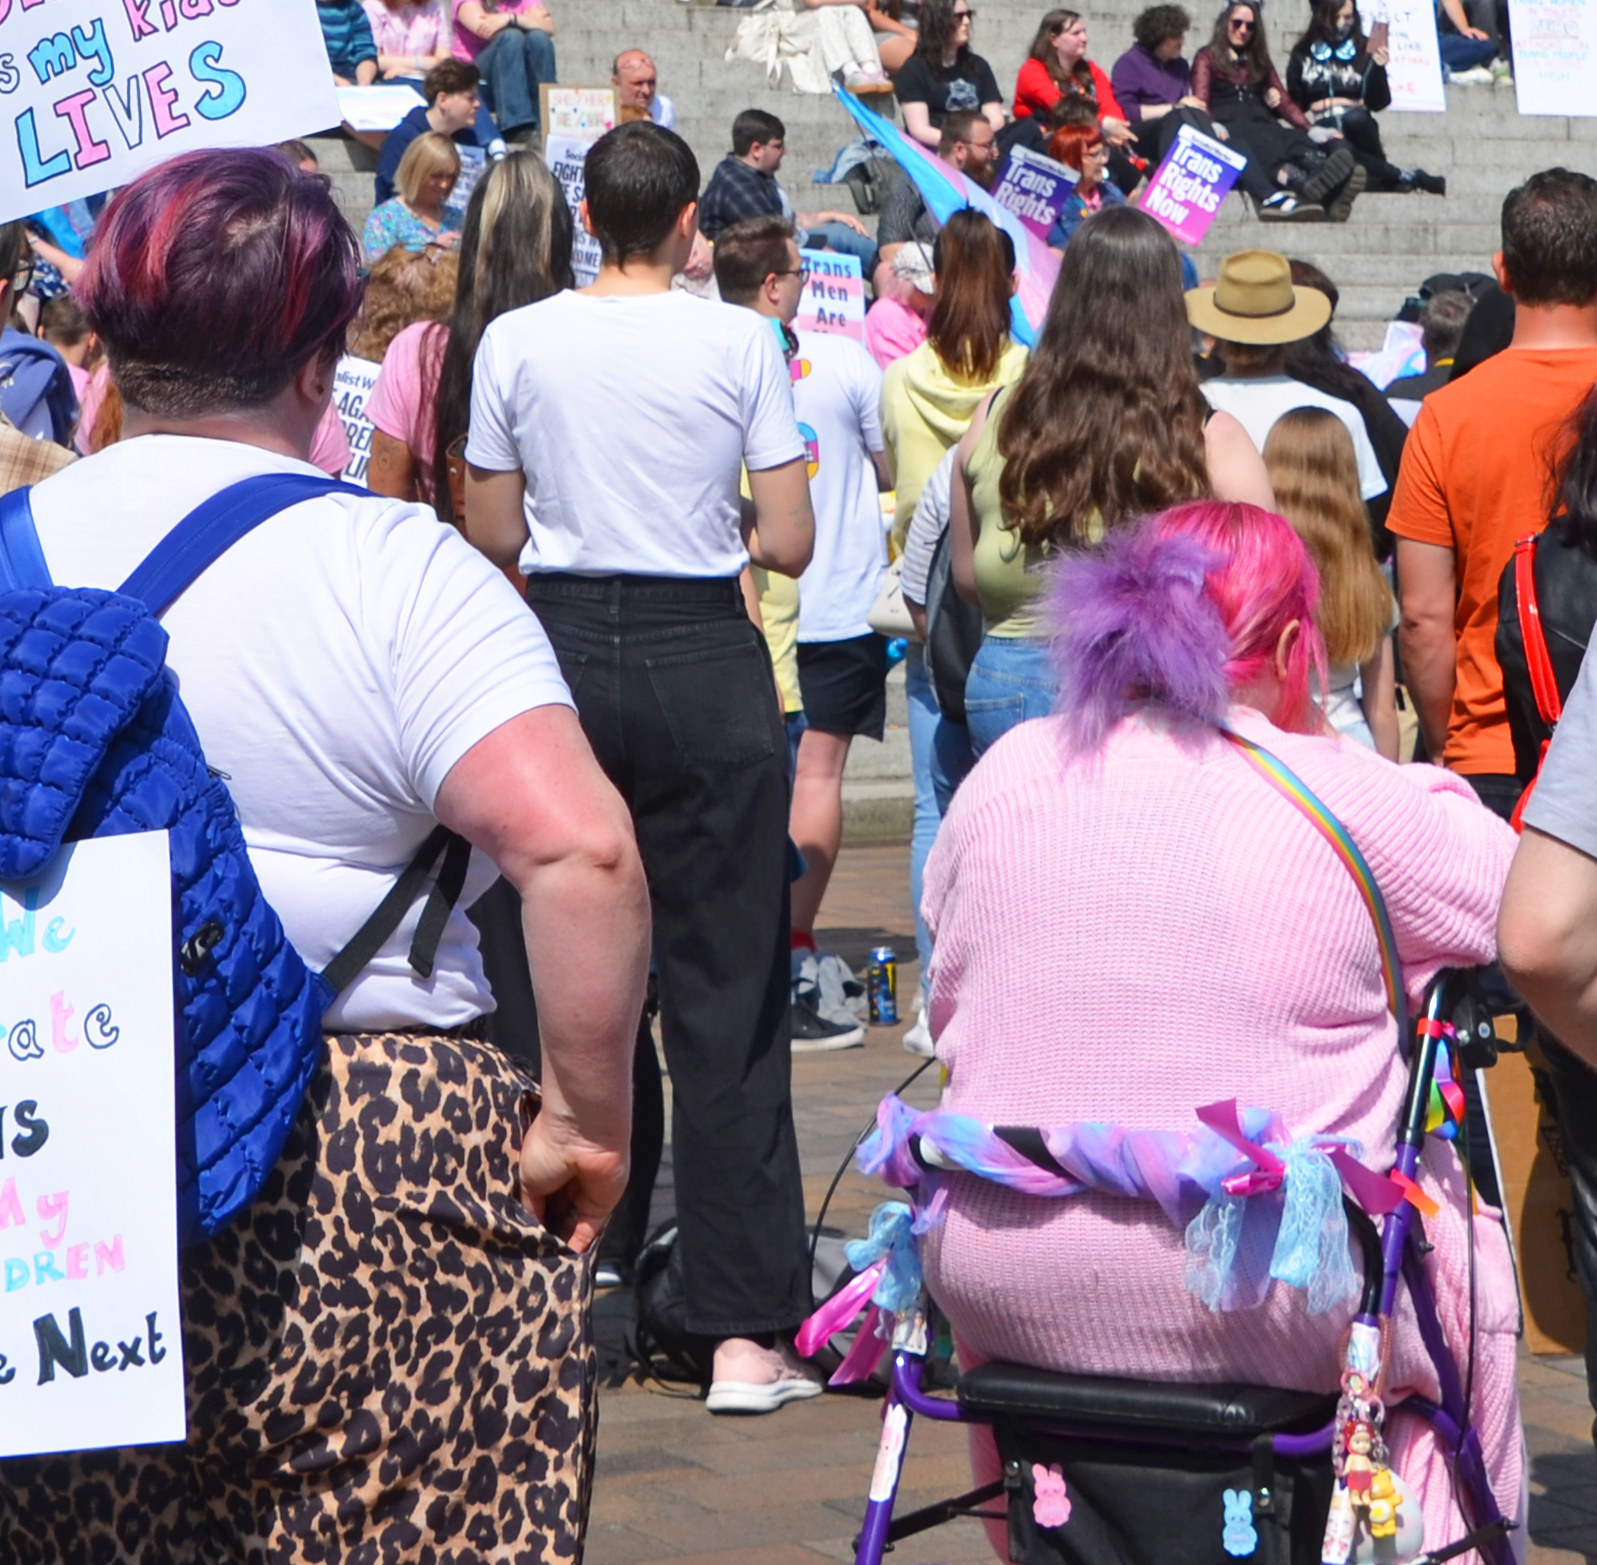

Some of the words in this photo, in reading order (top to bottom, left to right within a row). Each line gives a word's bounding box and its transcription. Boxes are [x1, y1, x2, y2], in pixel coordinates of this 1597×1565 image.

[27, 17, 114, 87] my
[14, 40, 247, 189] LIVES
[1005, 157, 1057, 198] Trans
[1172, 137, 1223, 183] Trans
[995, 181, 1056, 225] Rights
[1145, 184, 1190, 226] Now
[1159, 160, 1220, 213] Rights
[801, 256, 852, 279] Trans
[811, 279, 848, 302] Men
[816, 307, 846, 327] Are
[33, 1307, 167, 1386] Next
